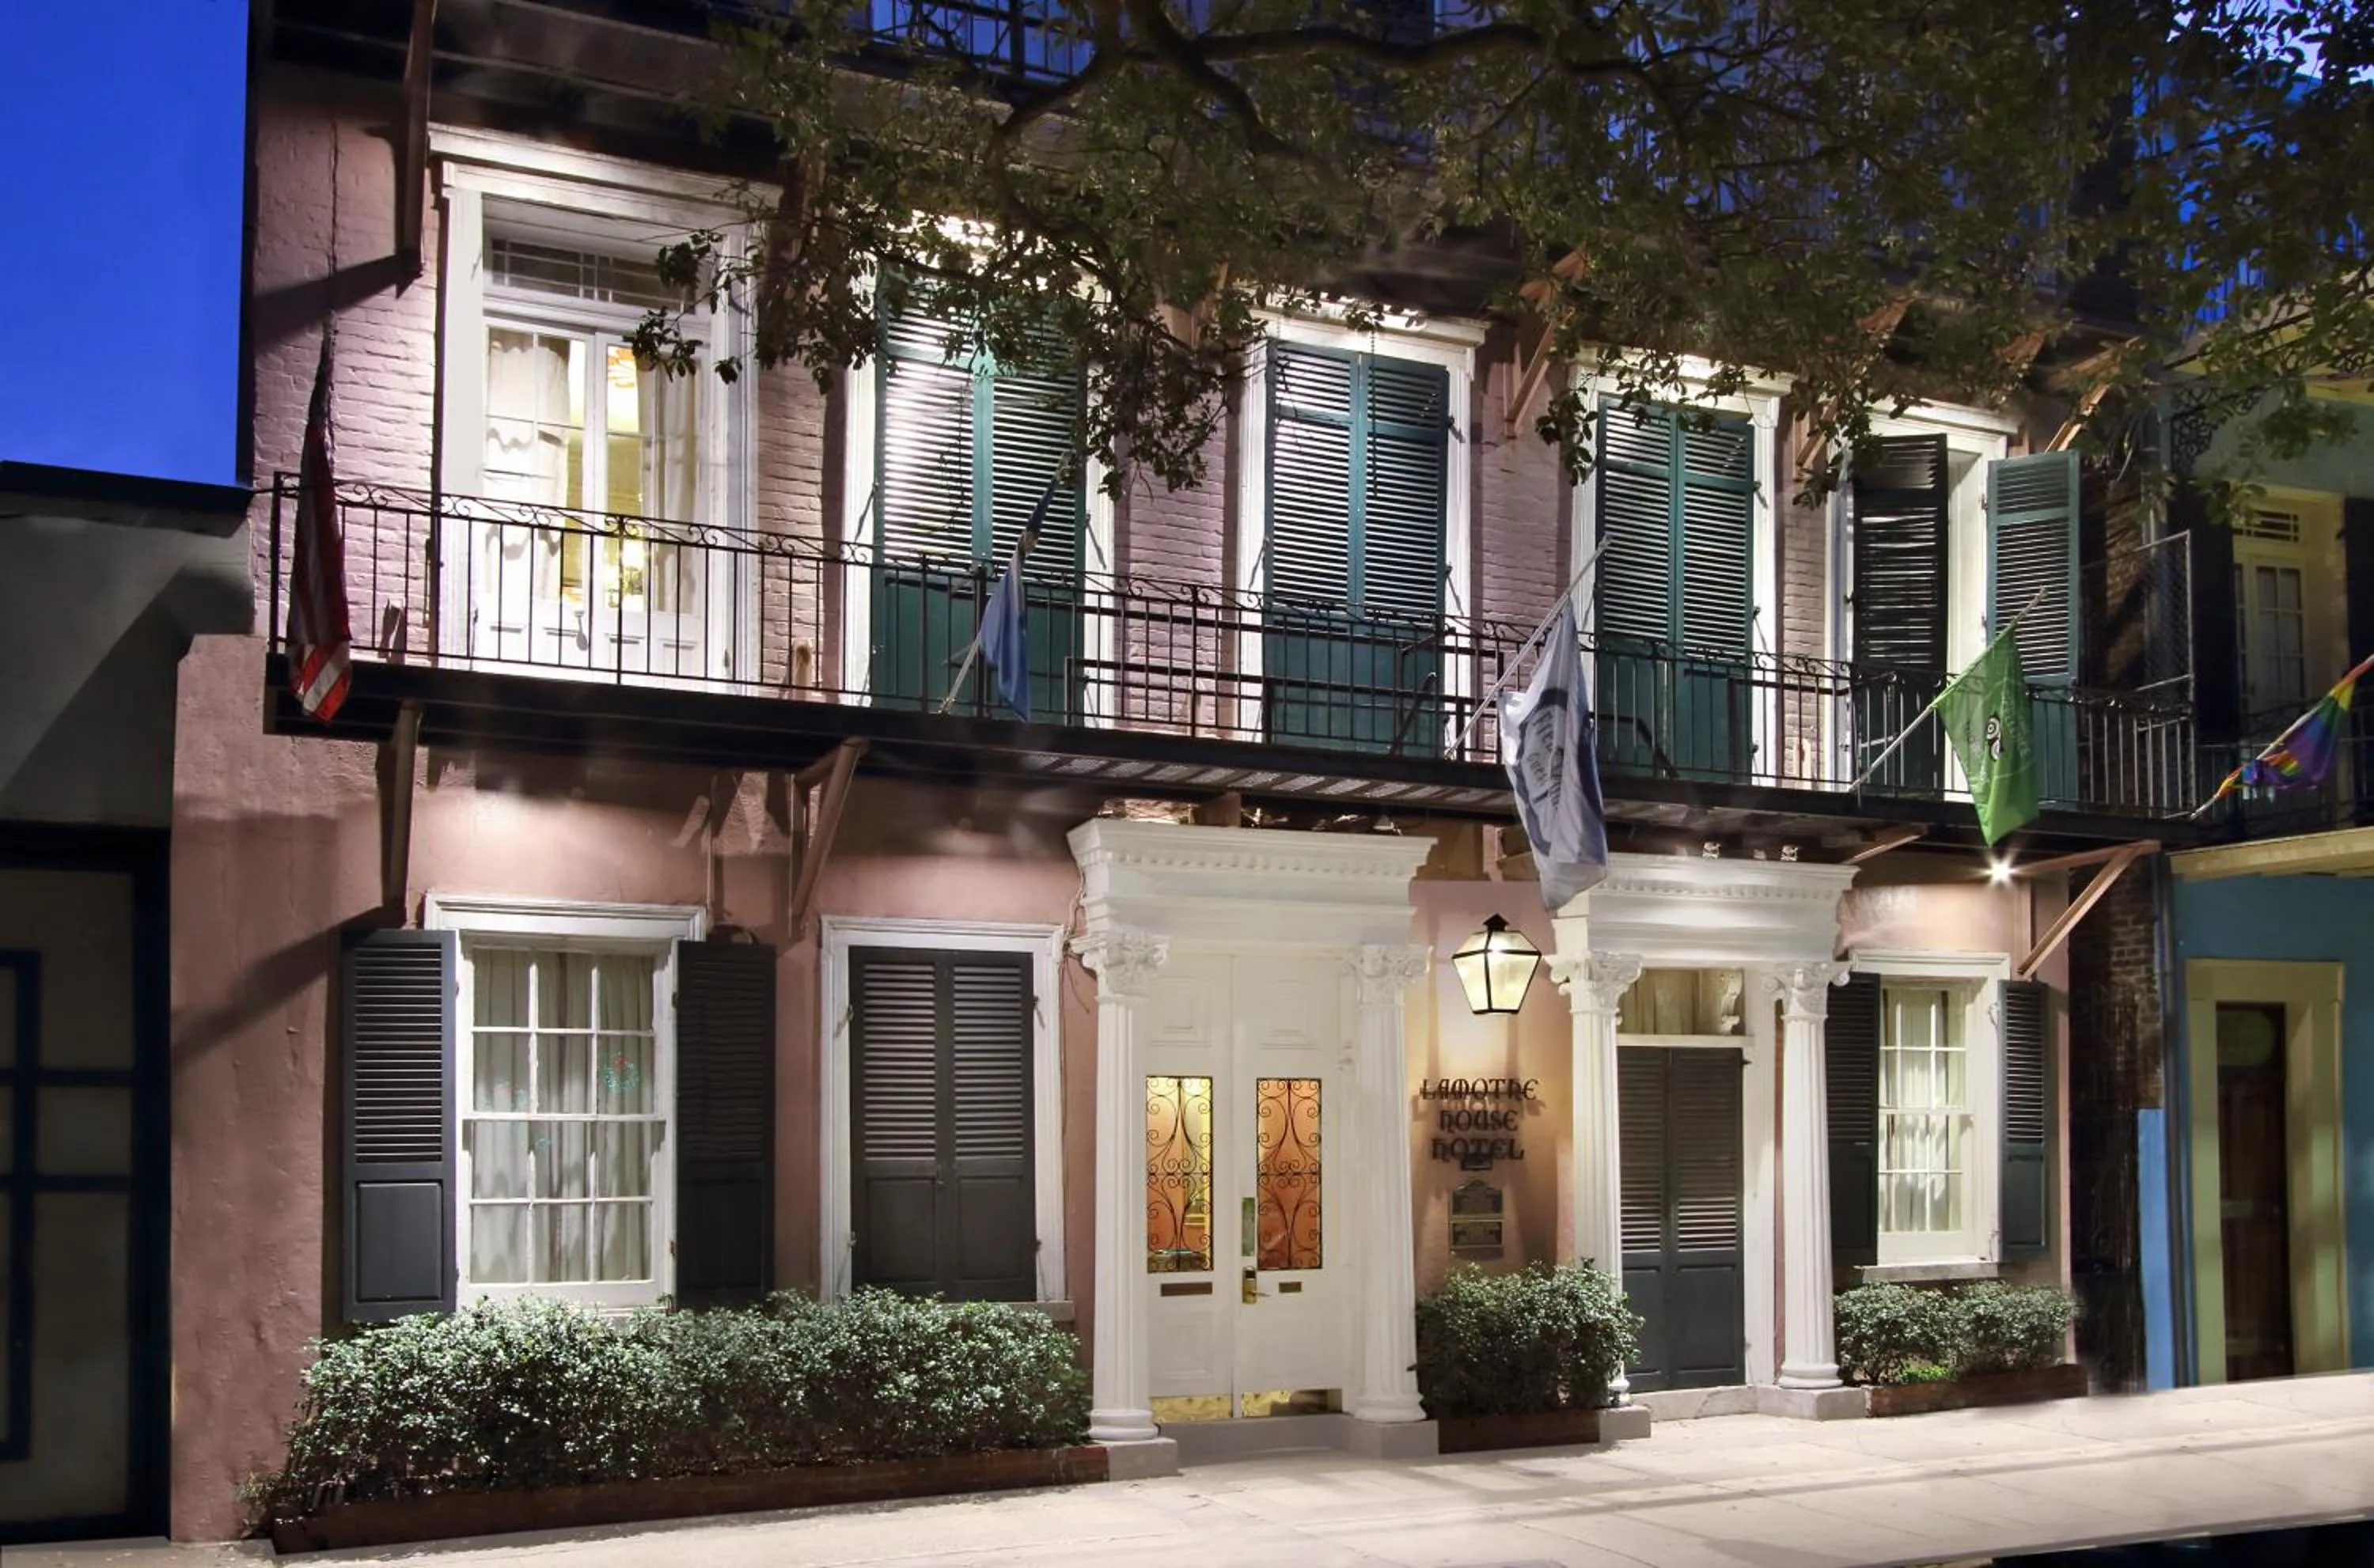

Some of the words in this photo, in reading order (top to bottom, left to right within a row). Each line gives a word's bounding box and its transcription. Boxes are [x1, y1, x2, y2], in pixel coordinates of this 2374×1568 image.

[1422, 1078, 1539, 1100] LAMOTHE
[1439, 1109, 1518, 1133] HOUSE
[1432, 1138, 1525, 1162] HOTEL
